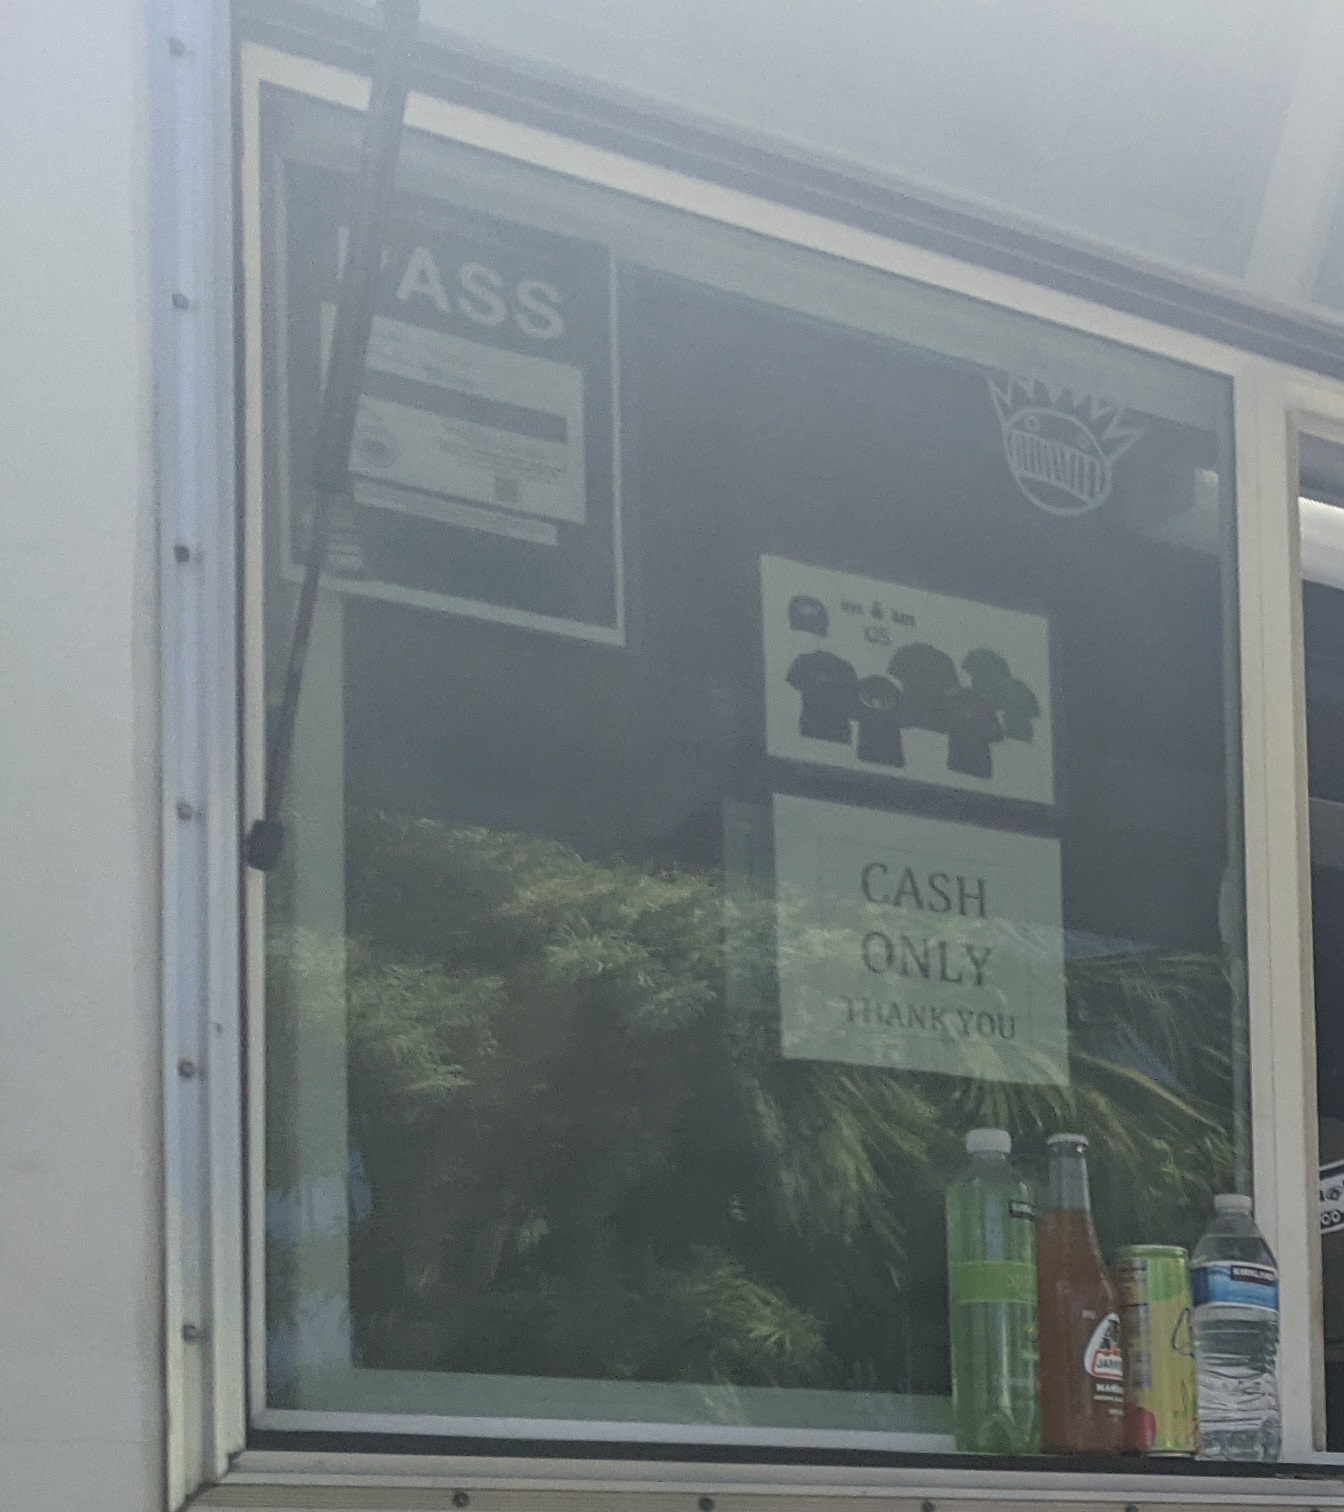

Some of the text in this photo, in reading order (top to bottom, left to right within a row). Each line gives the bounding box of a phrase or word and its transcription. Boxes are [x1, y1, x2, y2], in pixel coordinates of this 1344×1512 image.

[380, 247, 566, 339] ASS
[860, 862, 988, 919] CASH
[861, 931, 992, 987] ONLY
[845, 997, 1017, 1039] THANK YOU
